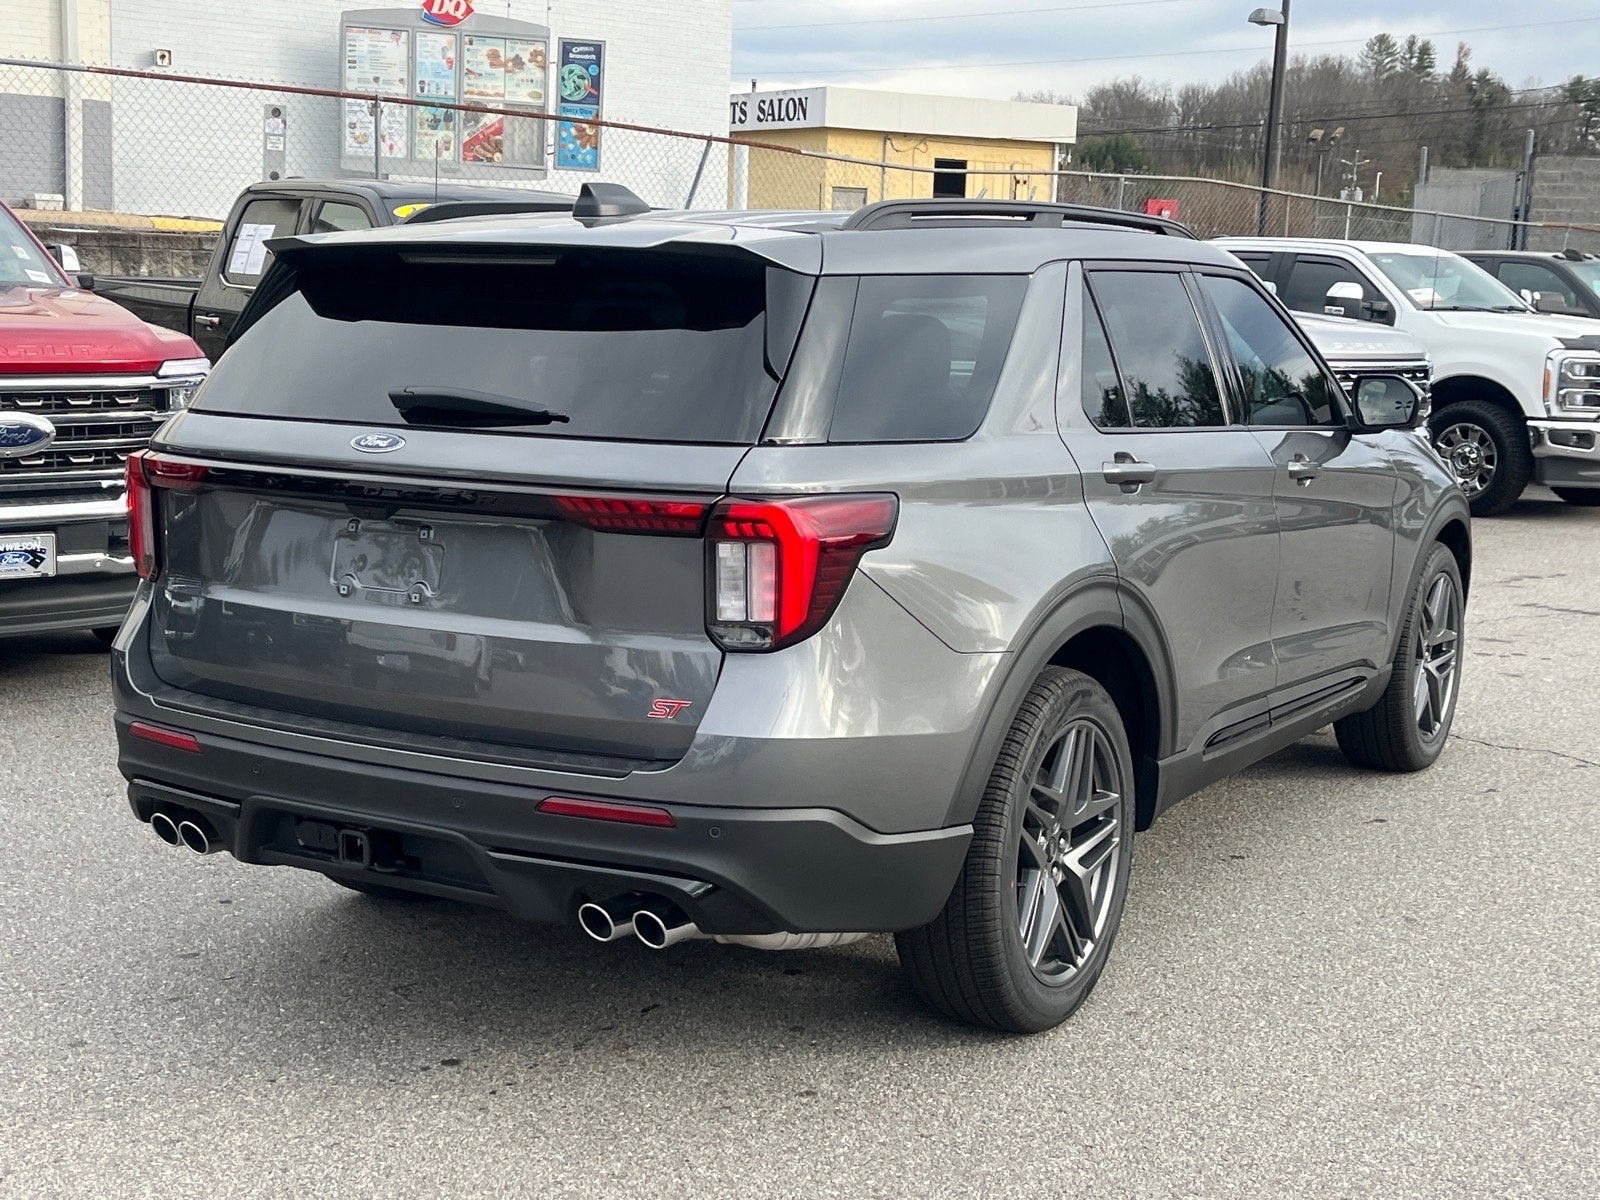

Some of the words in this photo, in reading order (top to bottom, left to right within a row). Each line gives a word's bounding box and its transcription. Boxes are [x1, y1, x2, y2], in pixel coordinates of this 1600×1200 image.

[430, 0, 467, 20] DQ
[730, 101, 748, 124] TS
[756, 97, 809, 123] SALON
[360, 433, 393, 447] Ford
[5, 540, 42, 552] WILSON
[1, 553, 26, 565] Ford
[647, 698, 693, 719] ST
